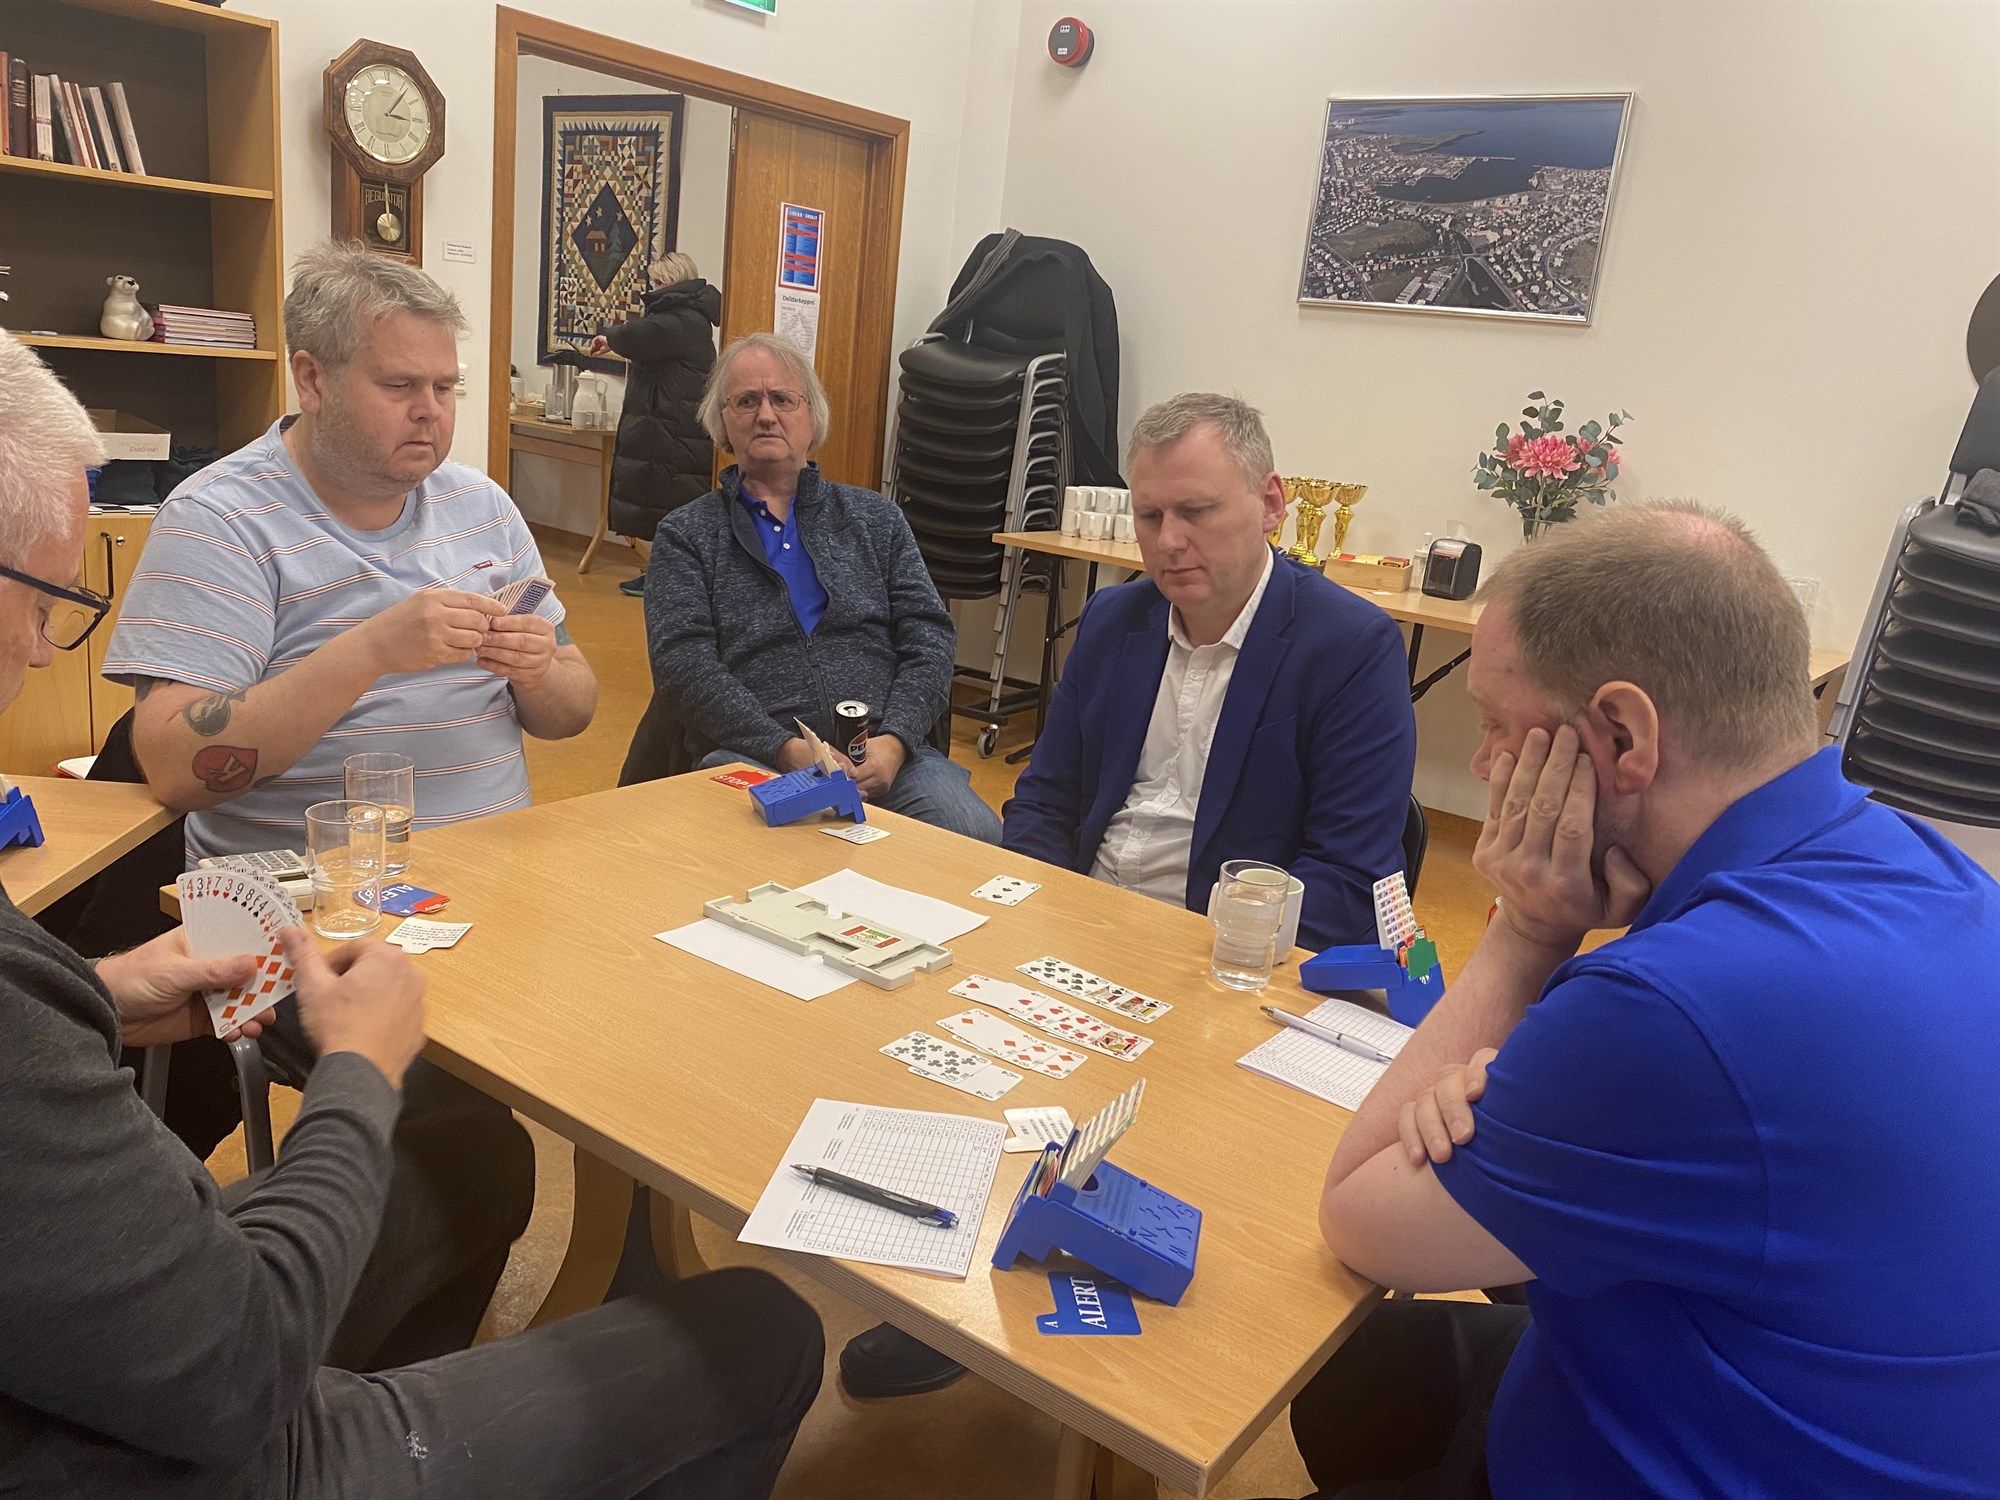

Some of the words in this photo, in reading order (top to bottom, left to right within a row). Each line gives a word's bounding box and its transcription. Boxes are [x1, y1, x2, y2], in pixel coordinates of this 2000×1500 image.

[365, 188, 403, 212] REGUATOR
[187, 879, 194, 891] 4
[197, 878, 203, 890] 3
[215, 876, 221, 888] 7
[226, 879, 233, 891] 3
[236, 883, 244, 895] 9
[246, 889, 255, 900] 8
[264, 910, 276, 920] A
[1069, 1276, 1107, 1329] ALERT
